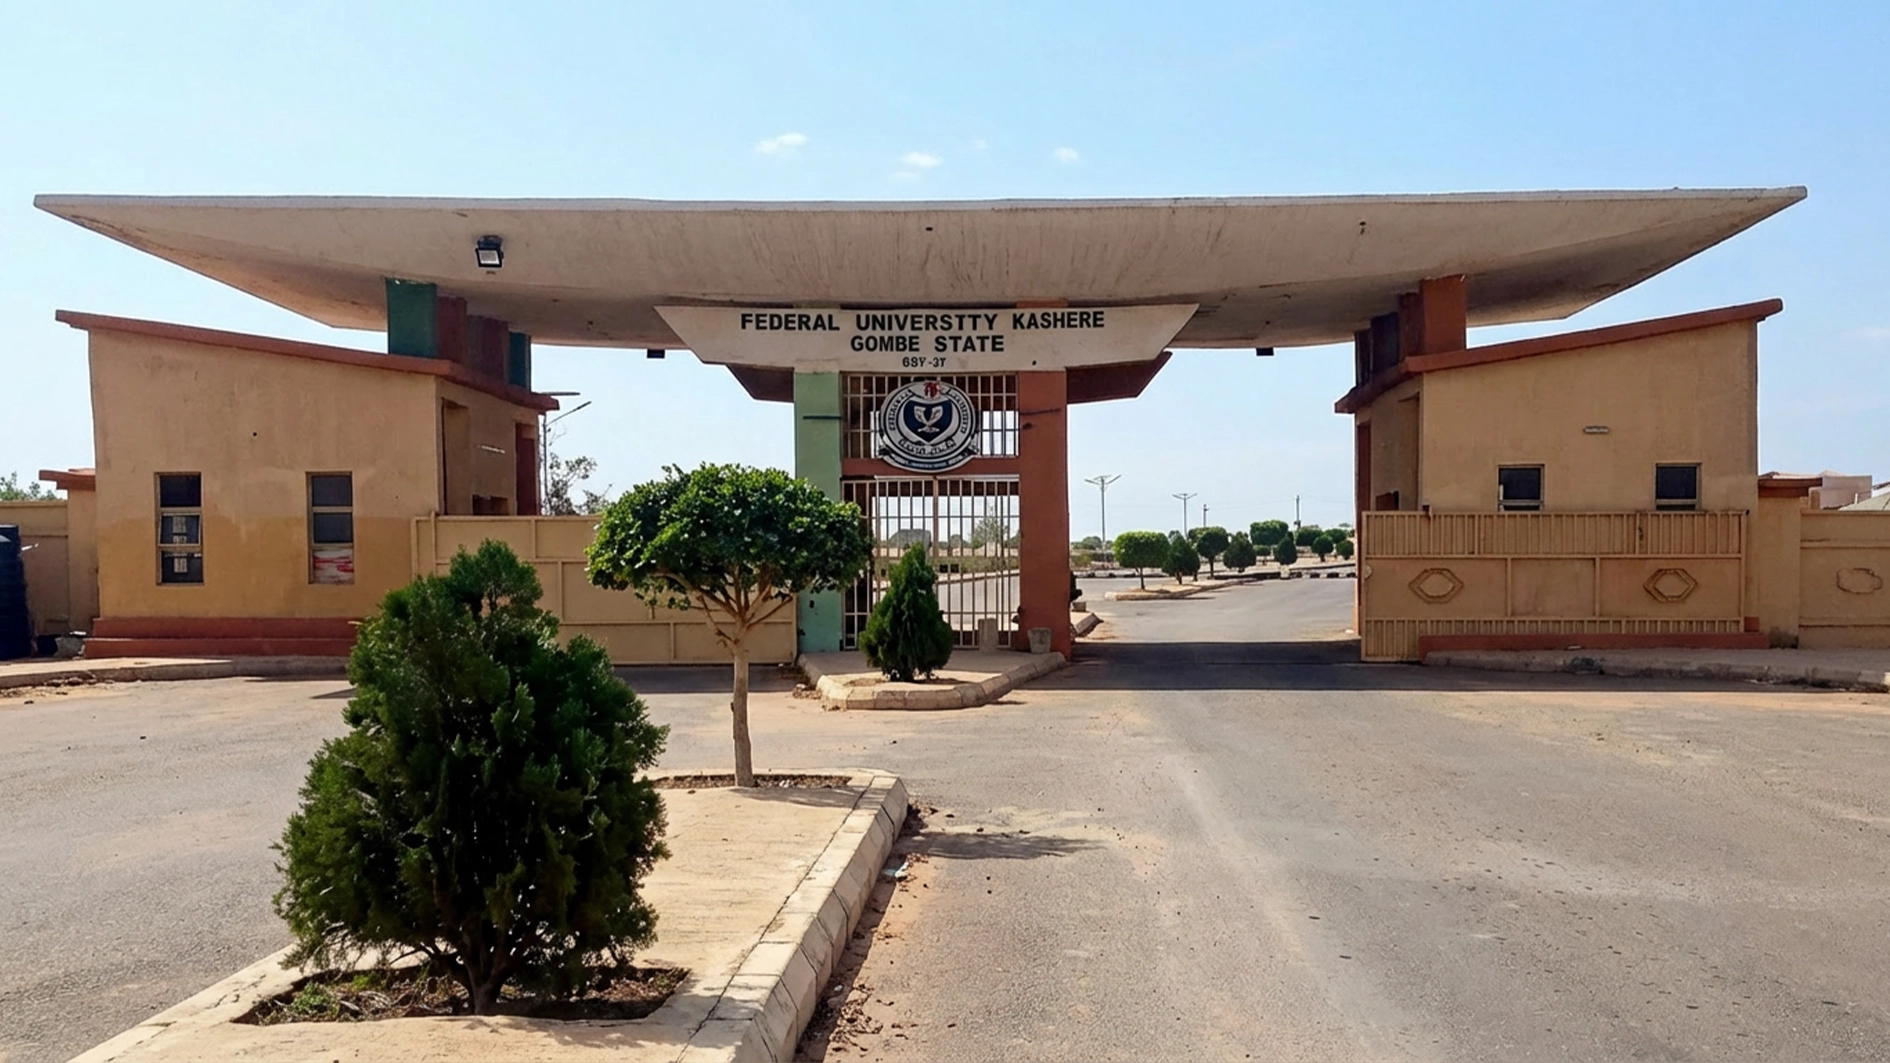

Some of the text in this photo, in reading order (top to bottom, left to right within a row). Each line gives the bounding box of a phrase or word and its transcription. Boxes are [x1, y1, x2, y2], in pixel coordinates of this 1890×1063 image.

[741, 313, 840, 331] FEDERAL
[1012, 311, 1105, 330] KASHERE
[850, 335, 1005, 352] GOMBE STATE
